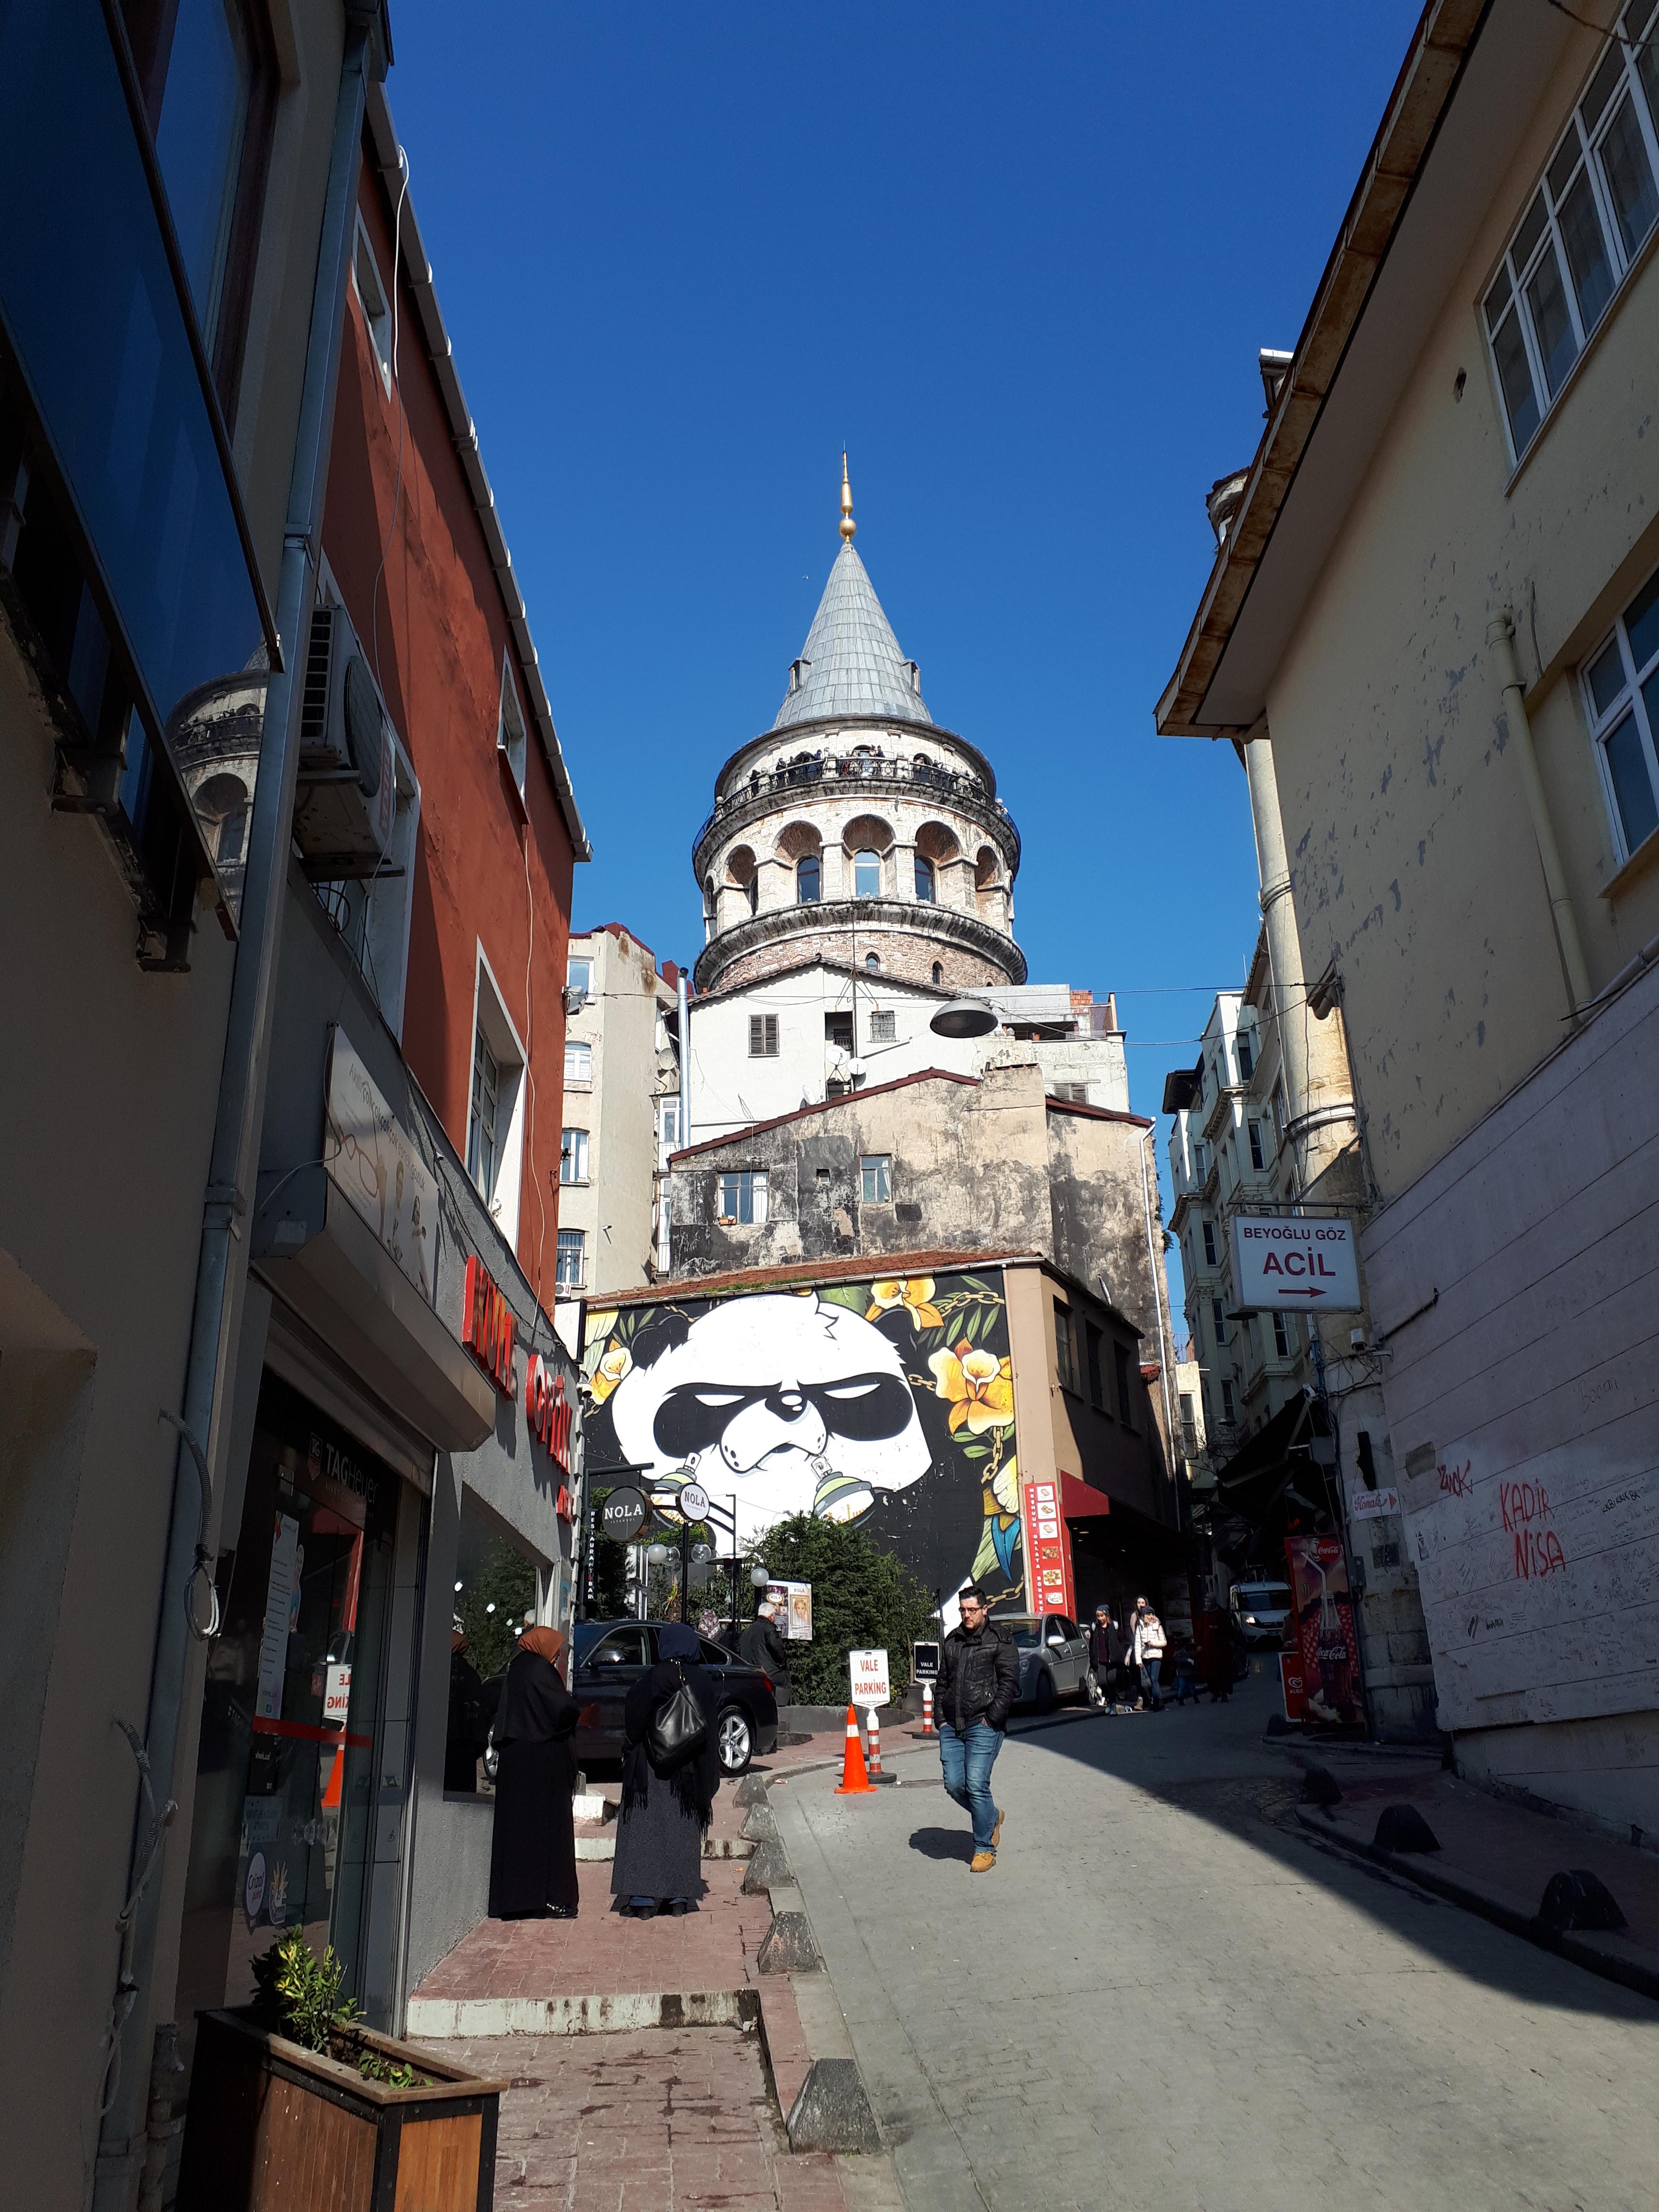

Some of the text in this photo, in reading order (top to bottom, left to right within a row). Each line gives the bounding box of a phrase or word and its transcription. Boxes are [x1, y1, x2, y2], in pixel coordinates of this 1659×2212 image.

[1243, 1226, 1346, 1241] BEYOĞLU GÖZ
[1262, 1247, 1336, 1276] ACİL
[684, 1491, 706, 1508] NOLA
[604, 1503, 644, 1520] NOLA
[1033, 1534, 1041, 1569] GALATA
[1318, 1546, 1339, 1554] Coca-Cola
[1317, 1646, 1347, 1660] Coca-Cola
[860, 1659, 878, 1672] VALE
[854, 1679, 887, 1695] PARKİNG
